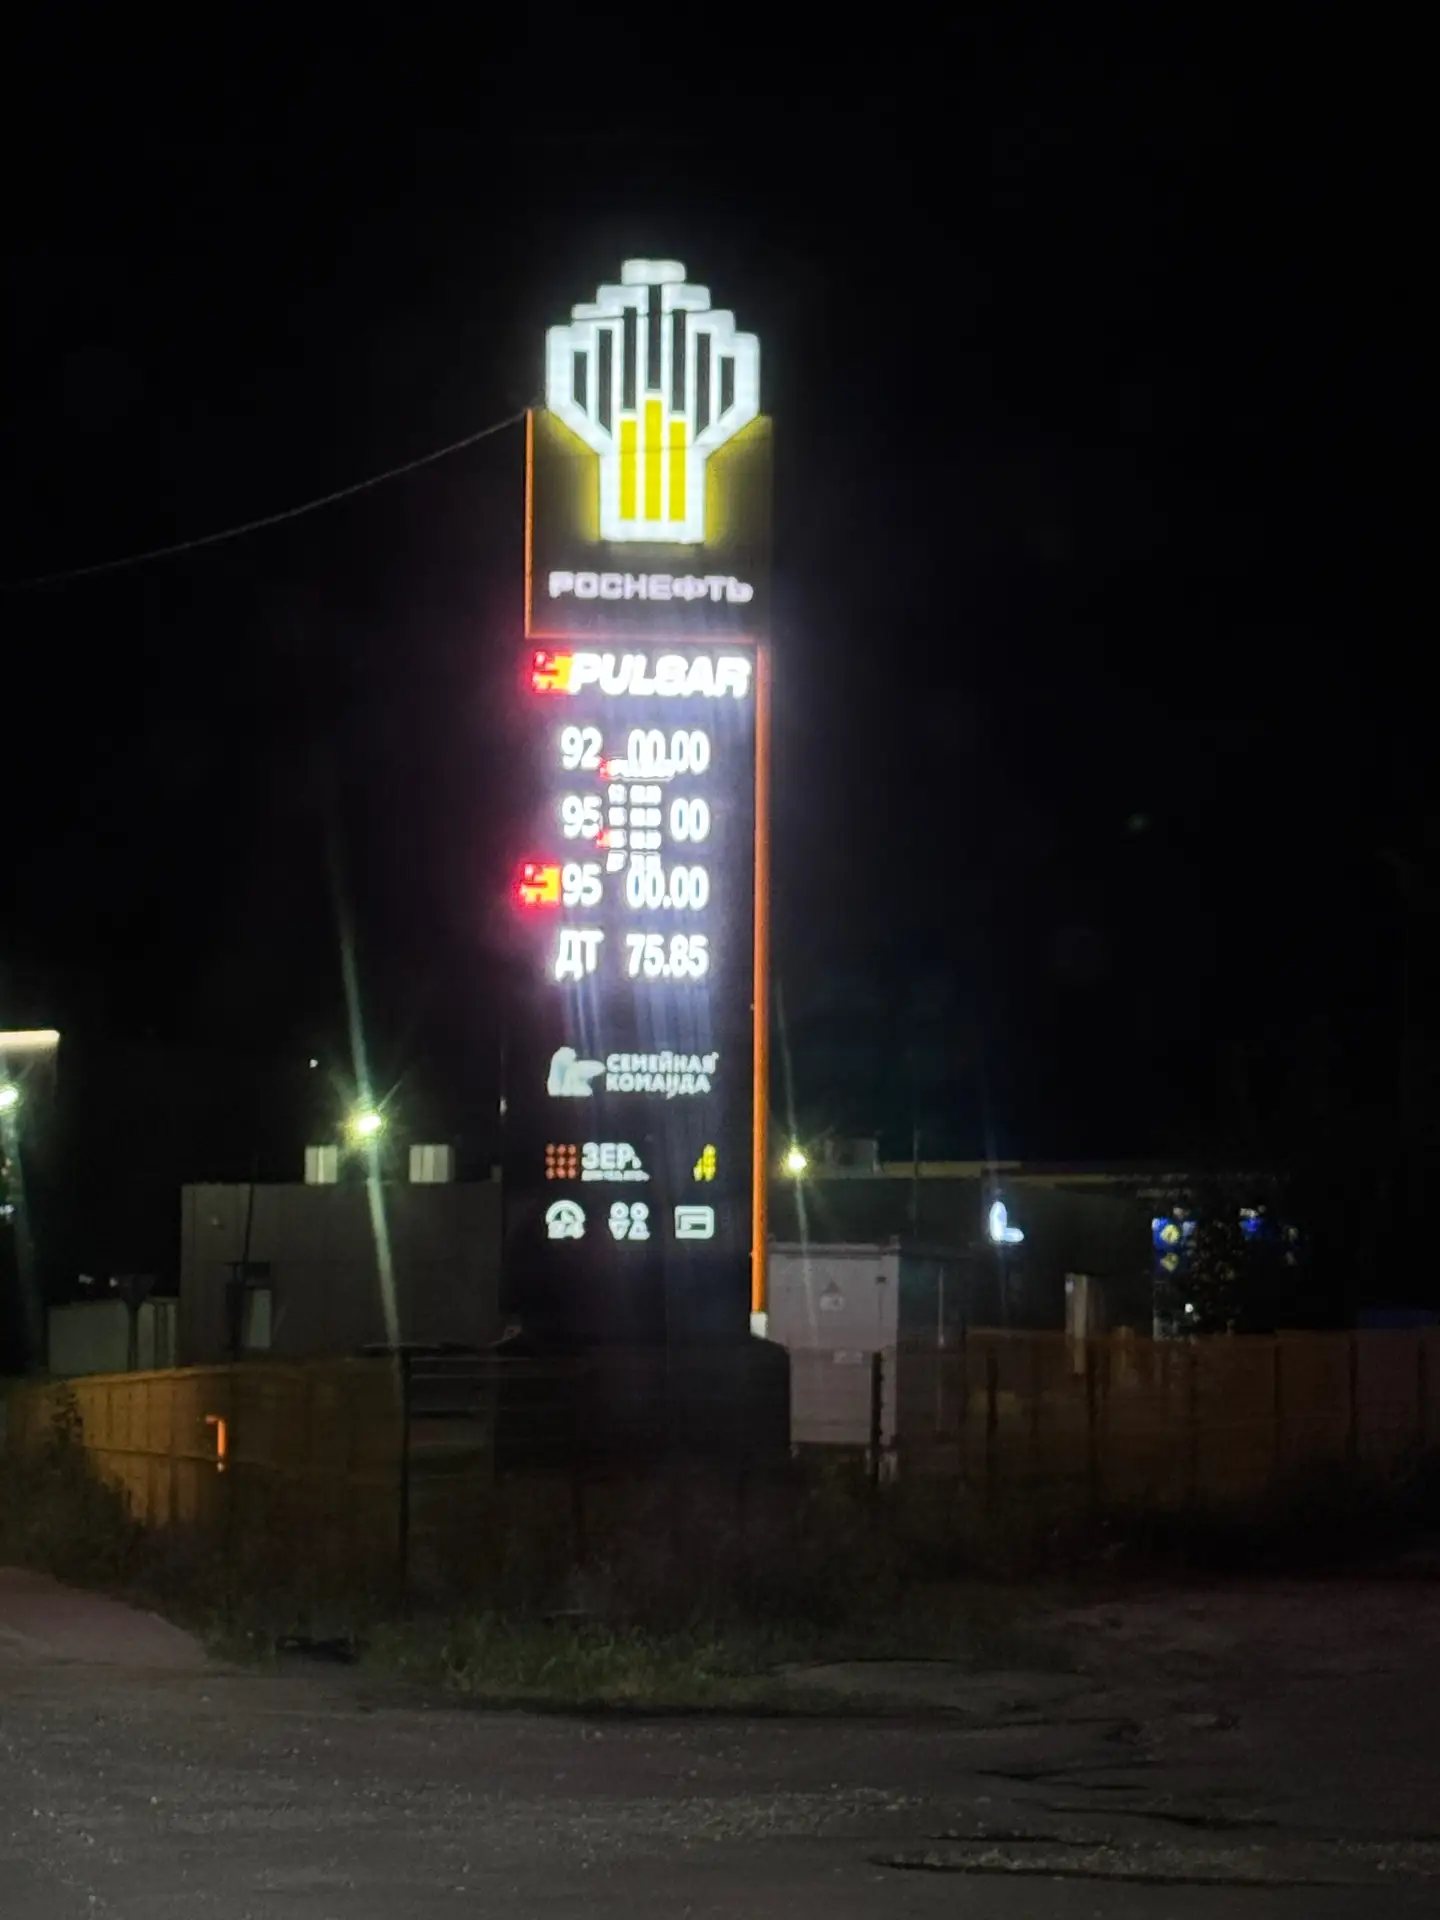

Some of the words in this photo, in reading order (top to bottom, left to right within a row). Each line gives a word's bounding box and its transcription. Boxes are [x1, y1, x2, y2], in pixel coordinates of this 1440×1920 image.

[549, 571, 754, 603] РОСНЕФТЬ
[569, 652, 751, 698] PULSAR
[560, 726, 604, 770] 92
[561, 795, 604, 838] 95
[561, 862, 603, 908] 95
[626, 865, 709, 909] 00.00
[555, 928, 604, 981] ДТ
[625, 934, 709, 977] 75.85
